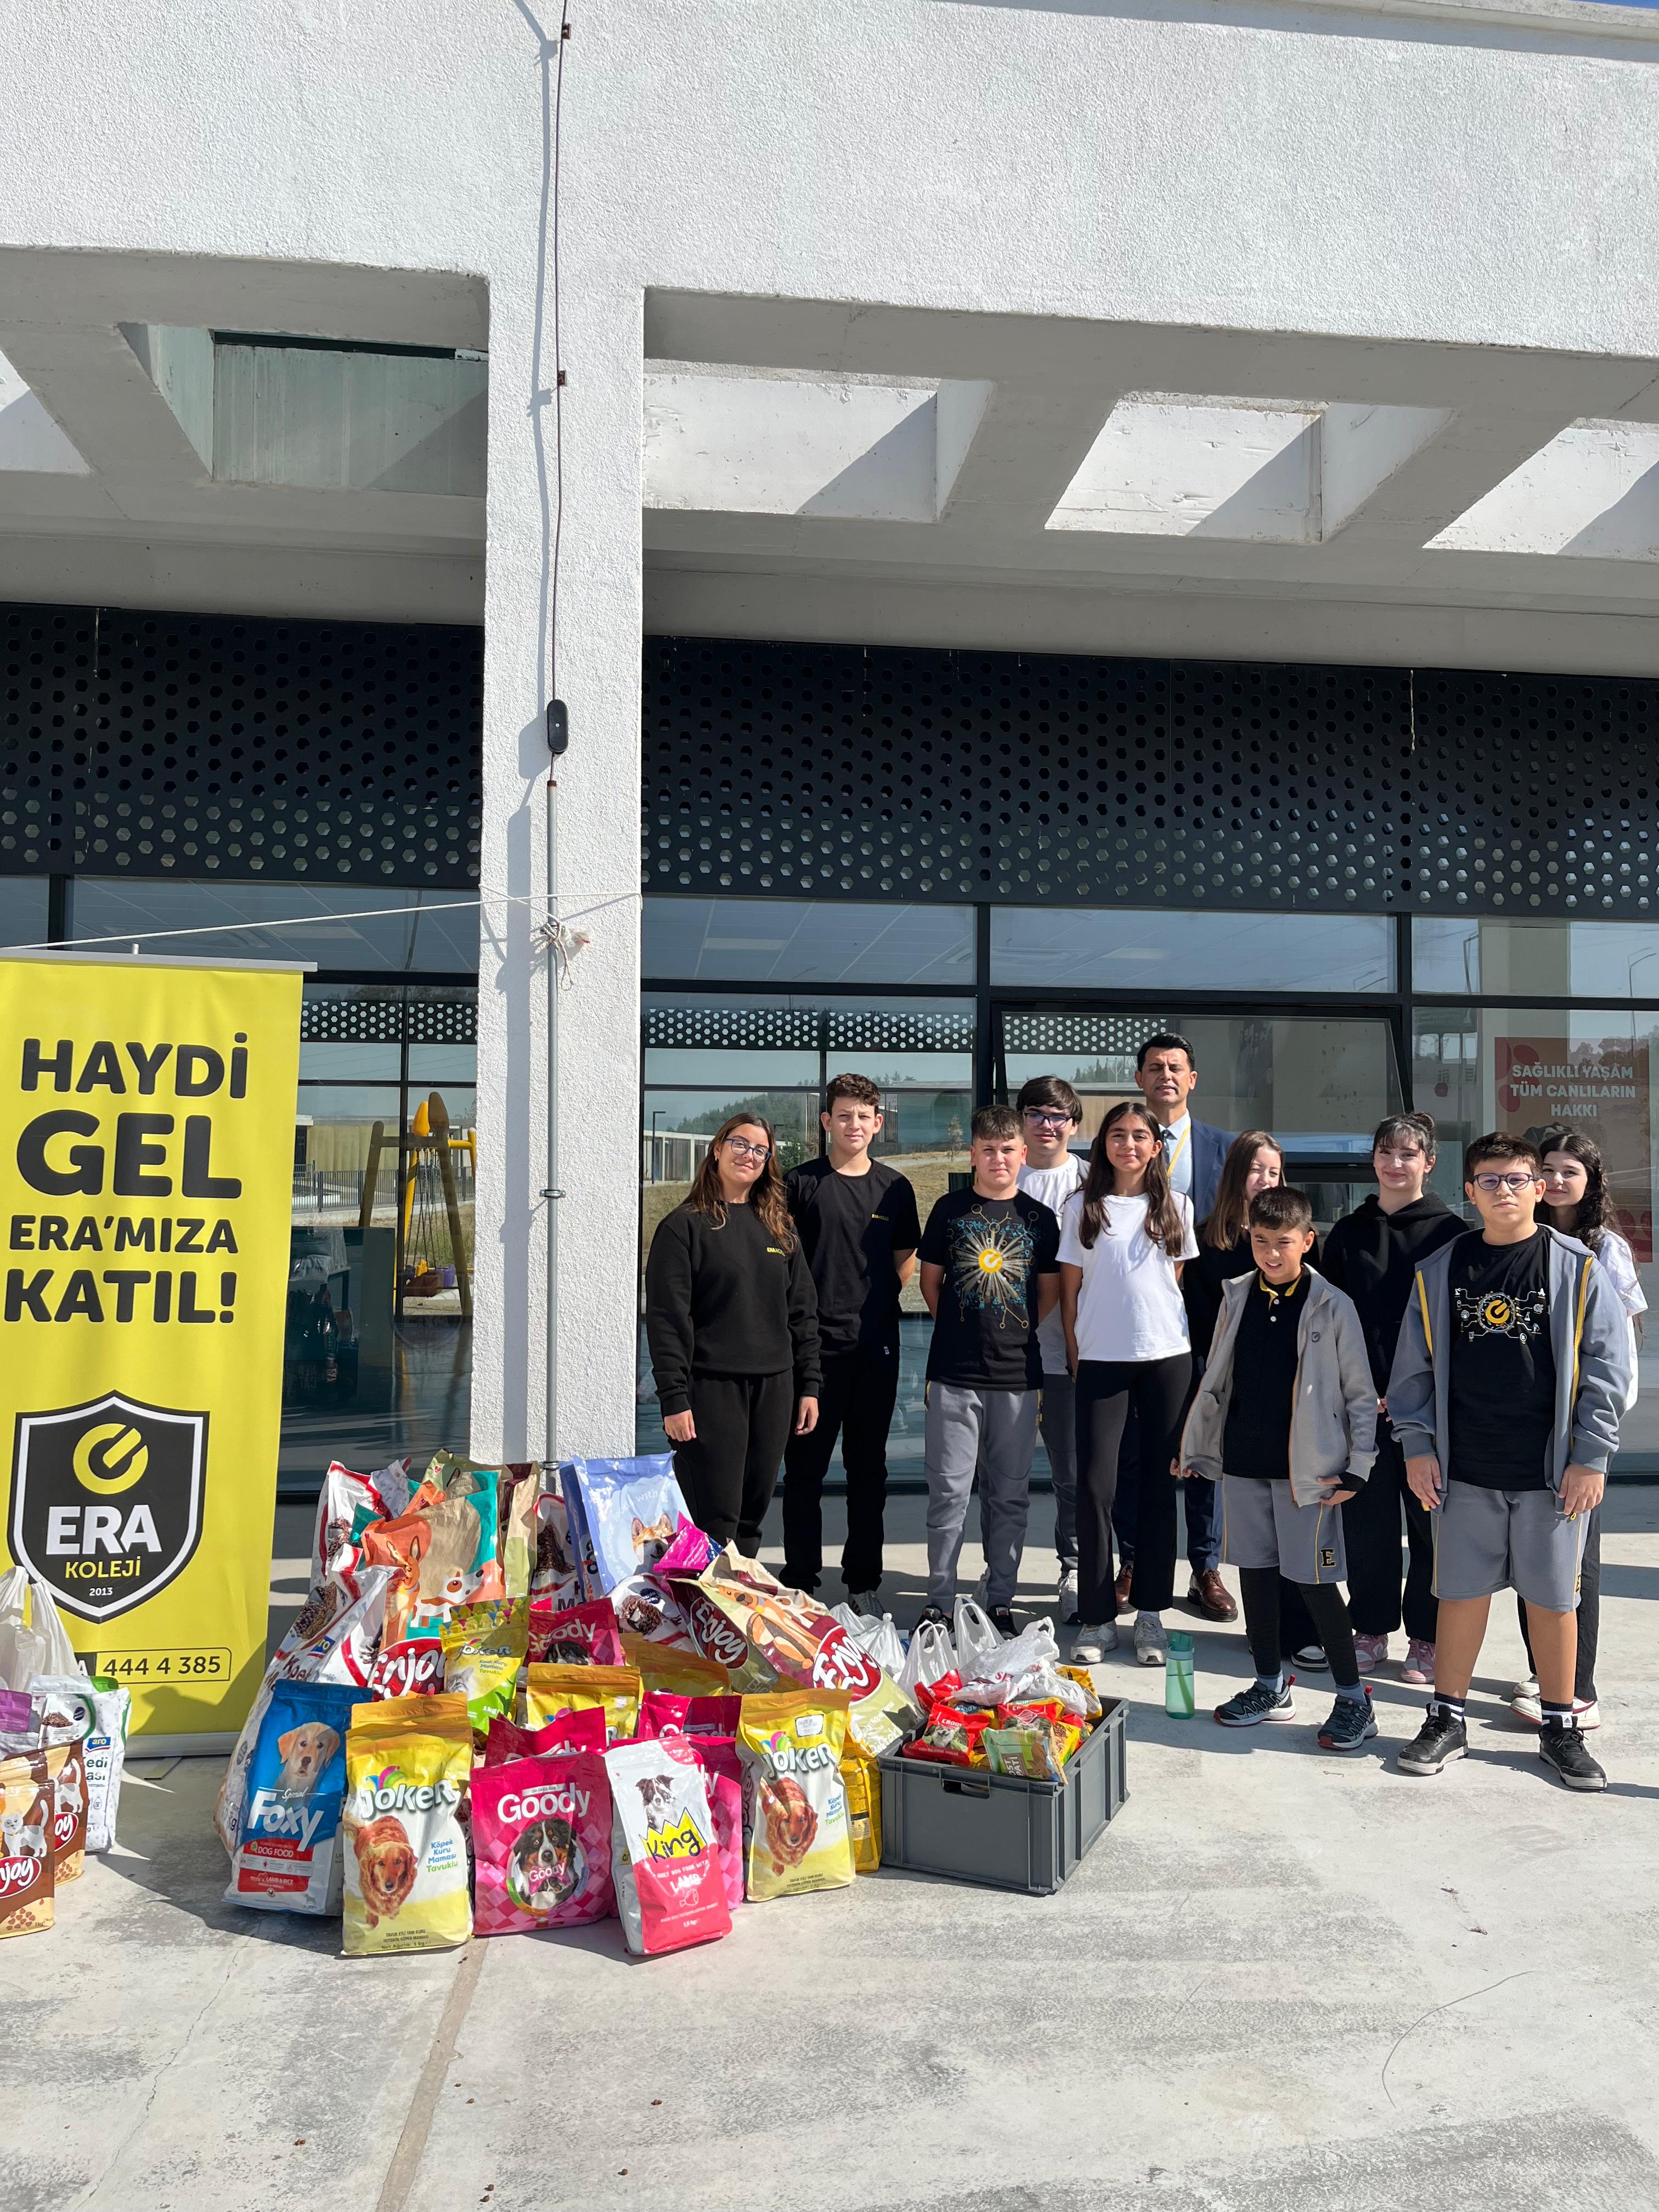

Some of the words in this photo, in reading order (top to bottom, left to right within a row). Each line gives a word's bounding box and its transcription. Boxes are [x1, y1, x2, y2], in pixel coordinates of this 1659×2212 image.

[21, 1032, 248, 1099] HAYDİ
[1512, 1062, 1580, 1078] SAĞLIKLI
[1582, 1065, 1633, 1081] YAŞAM
[1510, 1081, 1543, 1097] TÜM
[1546, 1084, 1636, 1098] CANLILARIN
[1550, 1103, 1597, 1117] HAKKI
[16, 1109, 242, 1199] GEL
[4, 1268, 237, 1323] KATIL!
[46, 1504, 162, 1555] ERA
[65, 1555, 142, 1579] KOLEJİ
[1320, 1548, 1336, 1567] E
[89, 1587, 114, 1597] 2013
[695, 1602, 747, 1664] Enjoy
[317, 1639, 330, 1650] ro
[103, 1657, 150, 1676] 444
[156, 1657, 171, 1674] 4
[179, 1655, 221, 1674] 385
[83, 1757, 109, 1768] edi
[281, 1786, 309, 1803] Special
[497, 1782, 590, 1824] Goody
[247, 1790, 325, 1852] Foxy
[258, 1846, 273, 1855] DOG
[274, 1848, 294, 1858] FOOD
[431, 1839, 454, 1849] Köpek
[433, 1847, 451, 1855] Kuru
[646, 1830, 701, 1864] King
[426, 1861, 458, 1873] Tavuklu
[427, 1853, 456, 1864] Maması
[0, 1857, 34, 1894] joy
